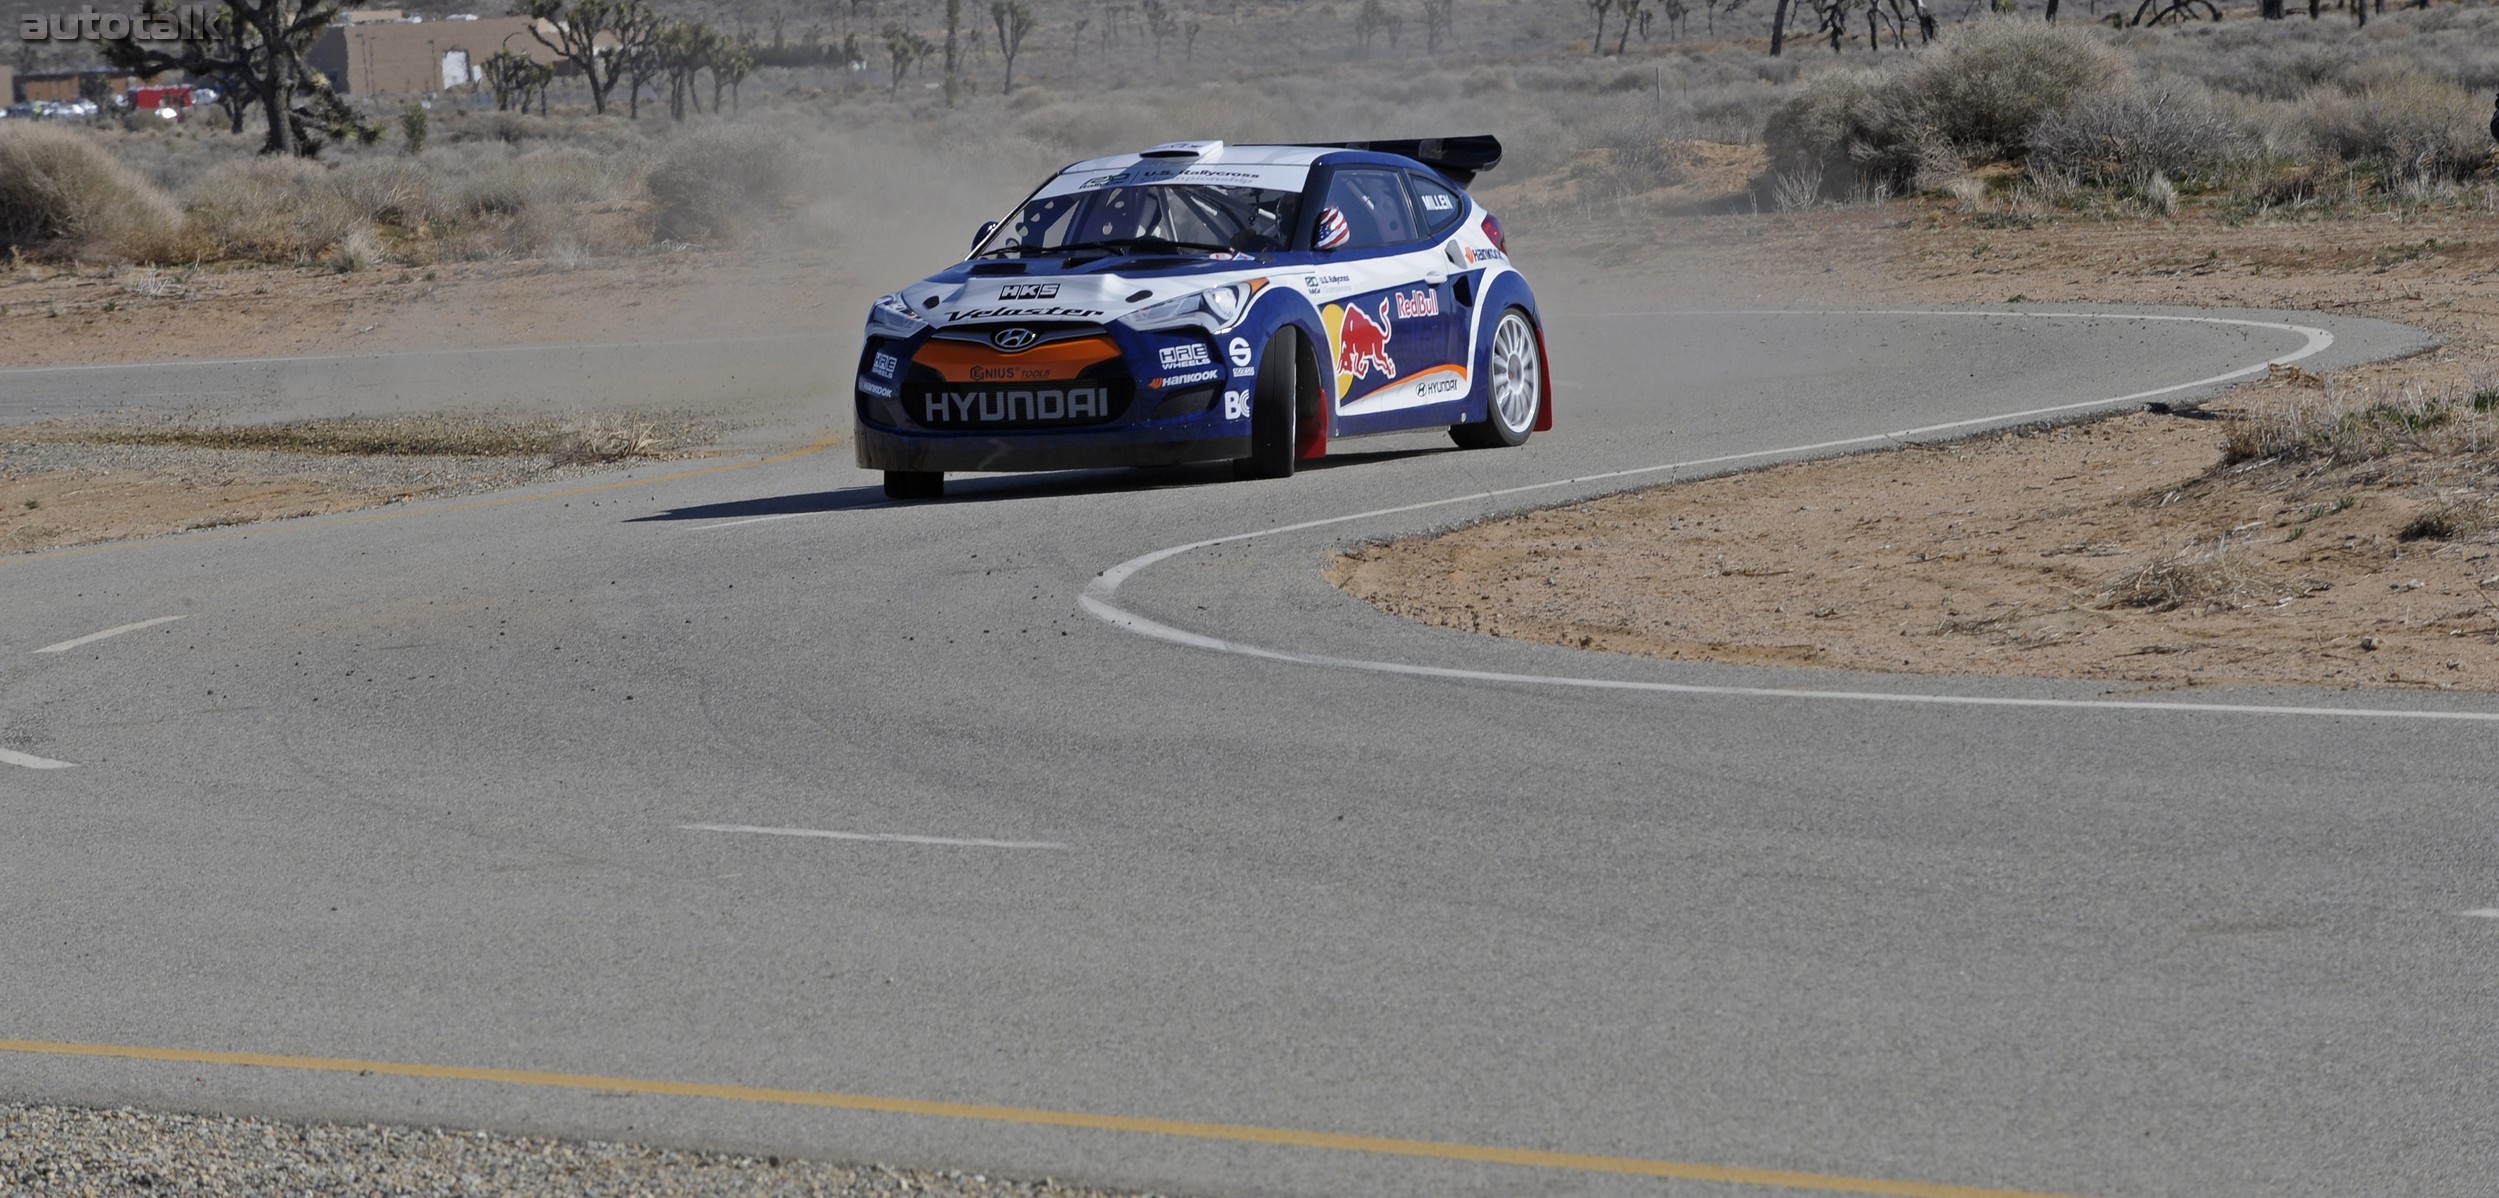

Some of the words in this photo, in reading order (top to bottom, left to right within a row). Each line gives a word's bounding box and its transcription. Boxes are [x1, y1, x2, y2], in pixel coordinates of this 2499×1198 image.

[1179, 169, 1259, 179] Rallycross
[1422, 194, 1453, 210] MILLEN
[999, 283, 1060, 300] HKS
[945, 306, 1104, 322] Veloster
[1159, 343, 1209, 364] HRE
[1162, 358, 1211, 370] WHEELS
[1428, 379, 1458, 395] HYUNDAI
[925, 387, 1108, 422] HYUNDAI
